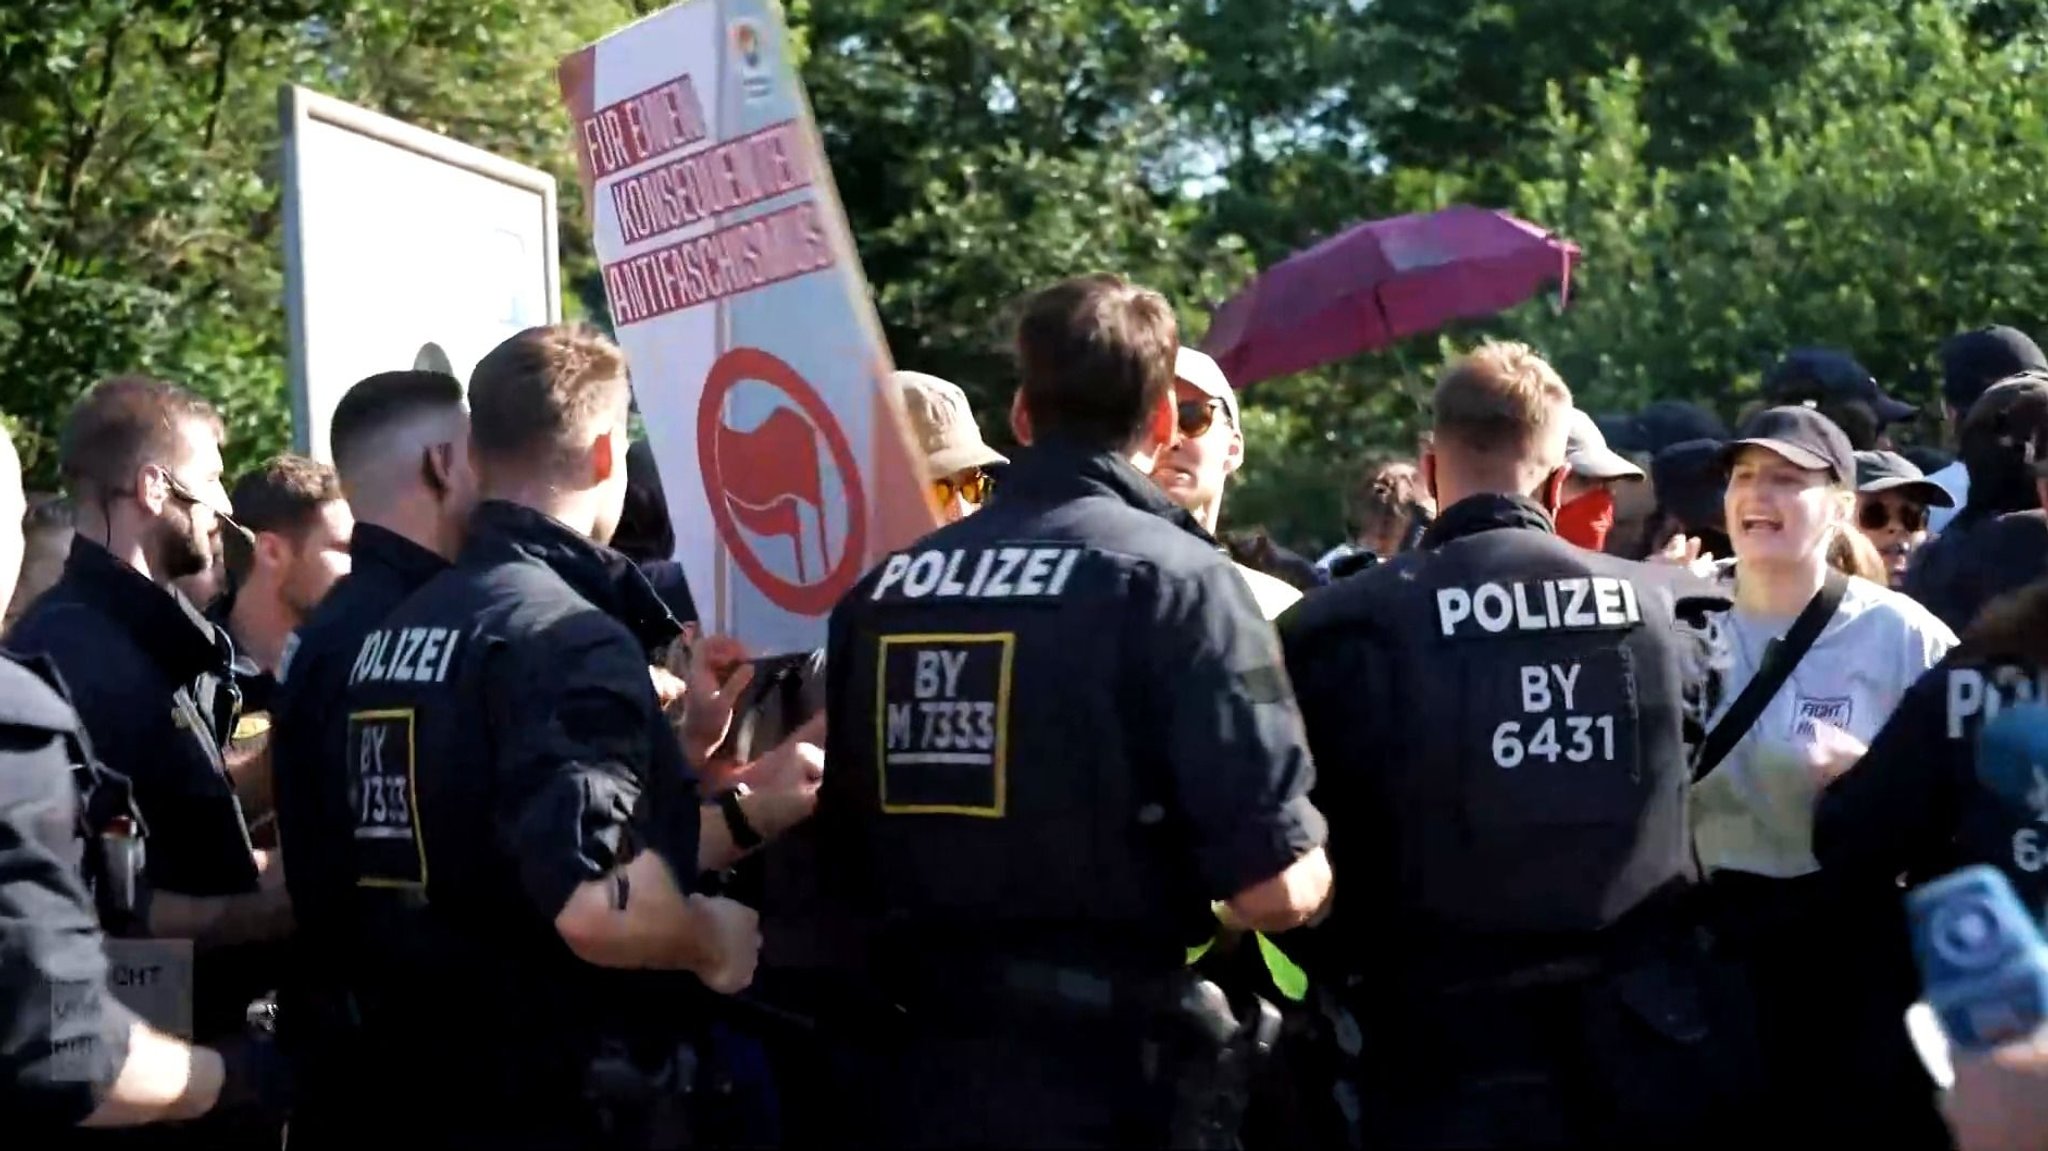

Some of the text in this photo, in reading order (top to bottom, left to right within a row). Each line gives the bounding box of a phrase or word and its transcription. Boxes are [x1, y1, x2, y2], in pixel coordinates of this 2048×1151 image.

[608, 203, 830, 323] ANTIFASCHISS
[870, 548, 1081, 601] POLIZEI
[1436, 577, 1641, 636] POLIZEI
[914, 650, 968, 698] BY
[1520, 663, 1582, 713] BY
[918, 701, 995, 749] 7333
[1492, 715, 1615, 768] 6431
